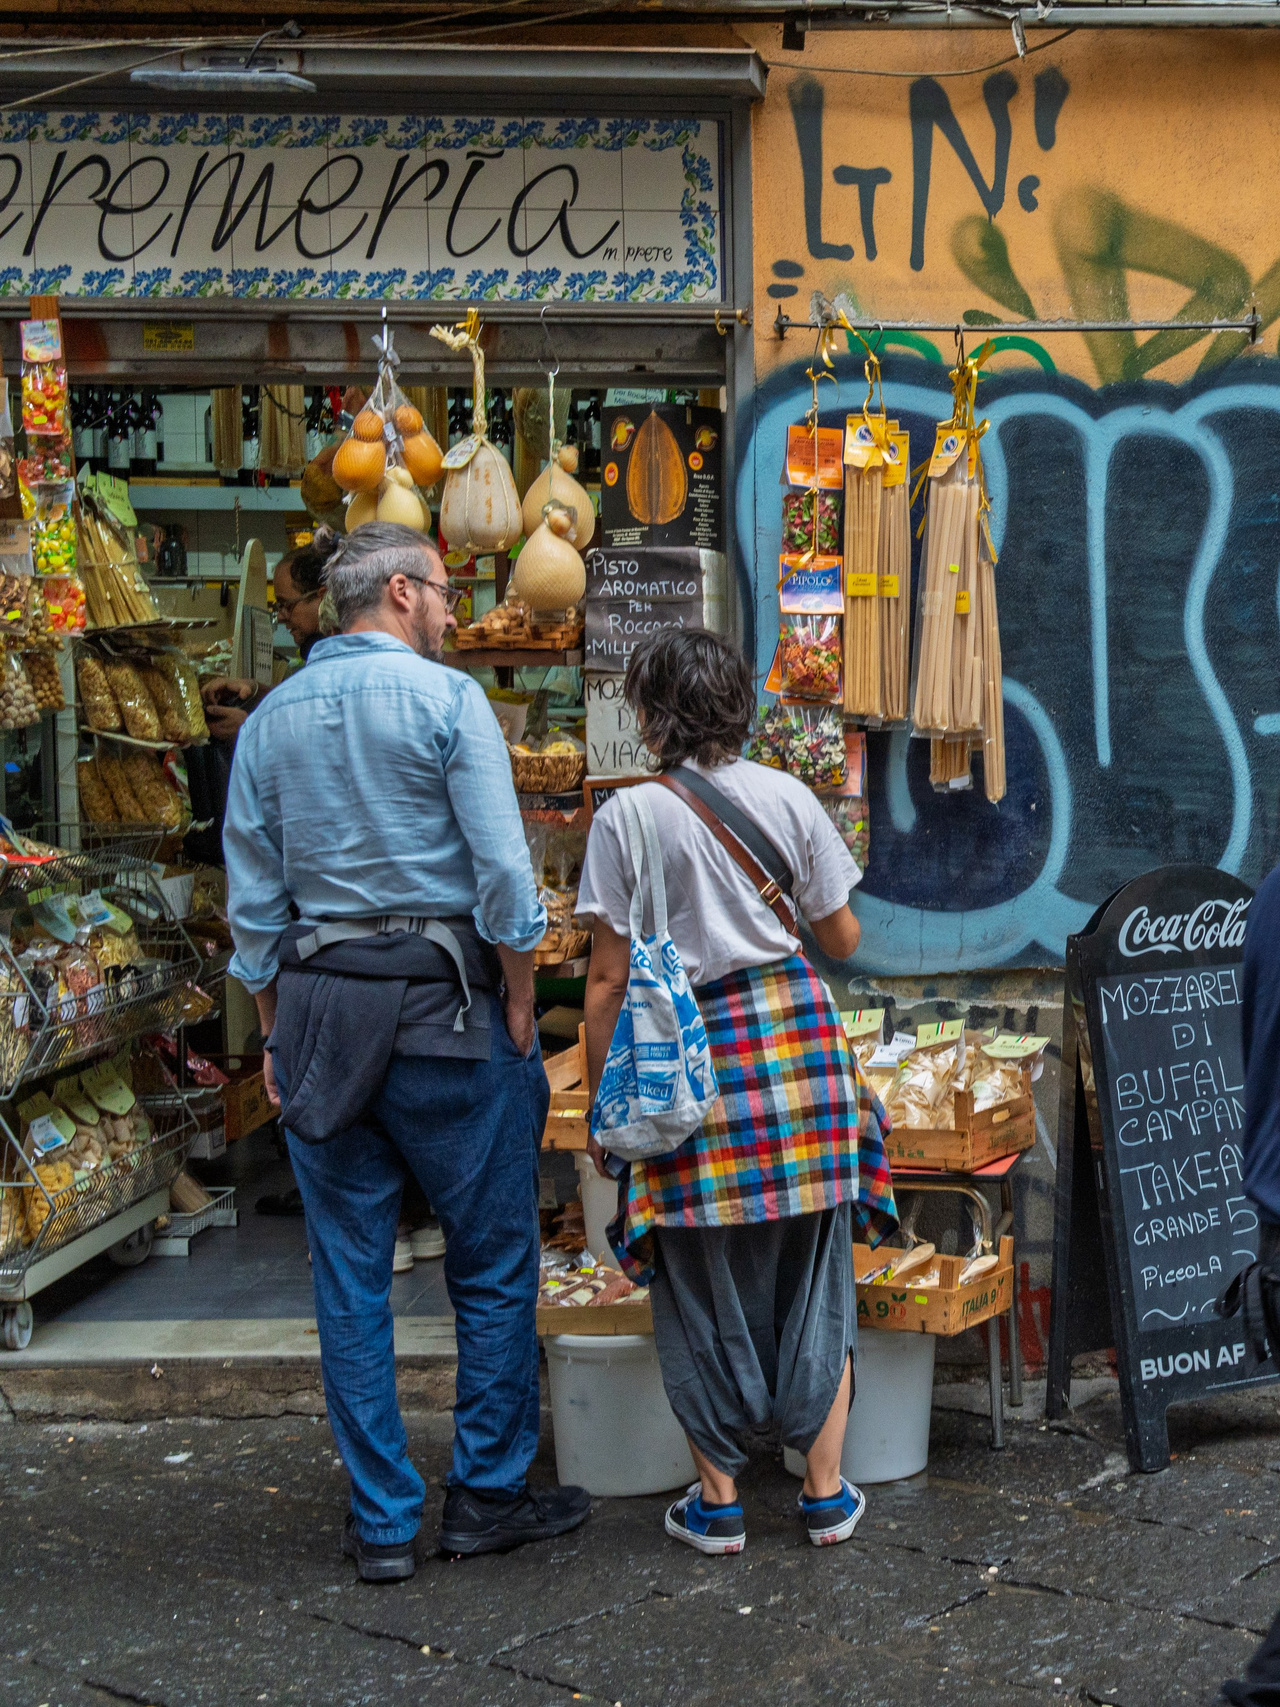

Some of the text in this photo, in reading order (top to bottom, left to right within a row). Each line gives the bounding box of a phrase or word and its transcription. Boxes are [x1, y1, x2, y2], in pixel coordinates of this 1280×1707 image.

[592, 551, 639, 577] PISTO
[598, 580, 698, 597] AROMATICO
[791, 575, 832, 587] PIPOLO
[629, 600, 653, 614] PER
[1118, 897, 1254, 958] Coca-Cola
[1133, 1206, 1222, 1247] GRANDE
[961, 1289, 990, 1318] ITALIA
[1140, 1350, 1211, 1382] BUON
